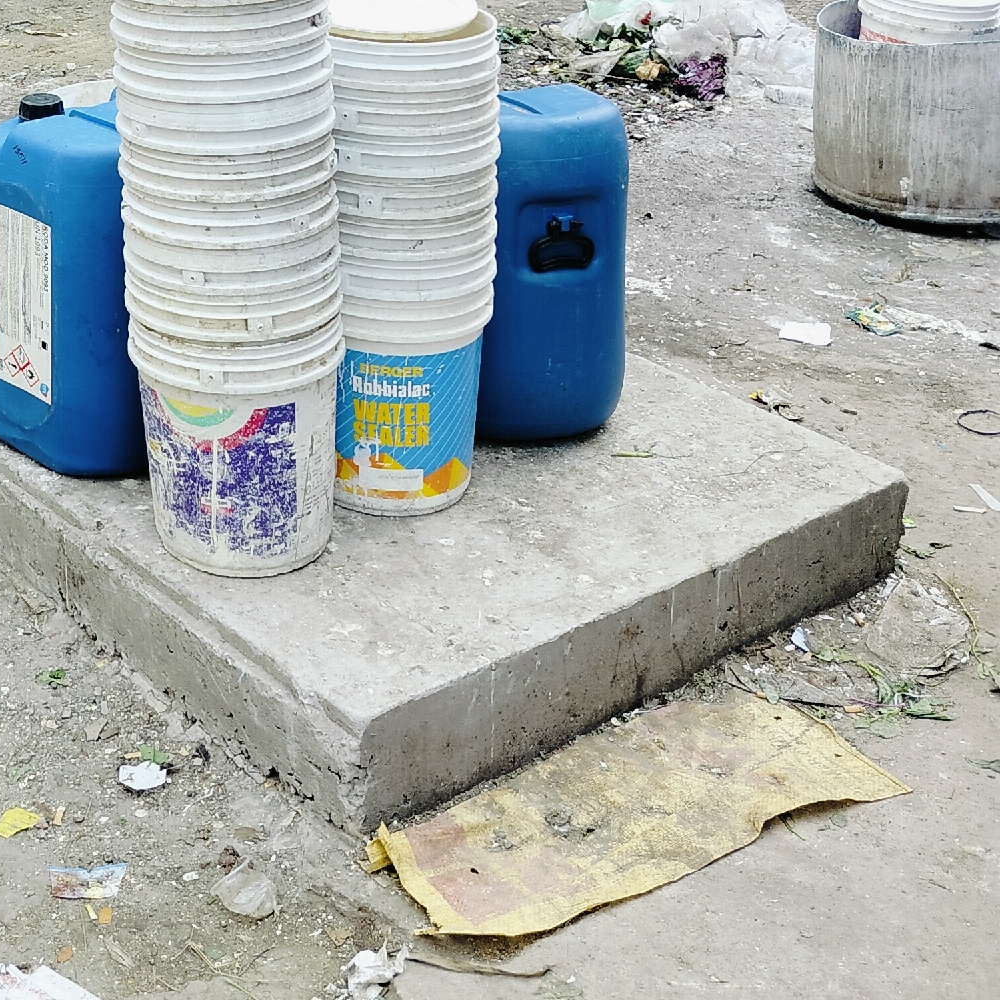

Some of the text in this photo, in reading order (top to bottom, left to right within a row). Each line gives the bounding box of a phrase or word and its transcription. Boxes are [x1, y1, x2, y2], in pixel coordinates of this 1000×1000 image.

[359, 363, 424, 378] BERGER
[353, 375, 430, 398] Robbialac
[353, 398, 430, 425] WATER
[353, 420, 430, 447] SEALER
